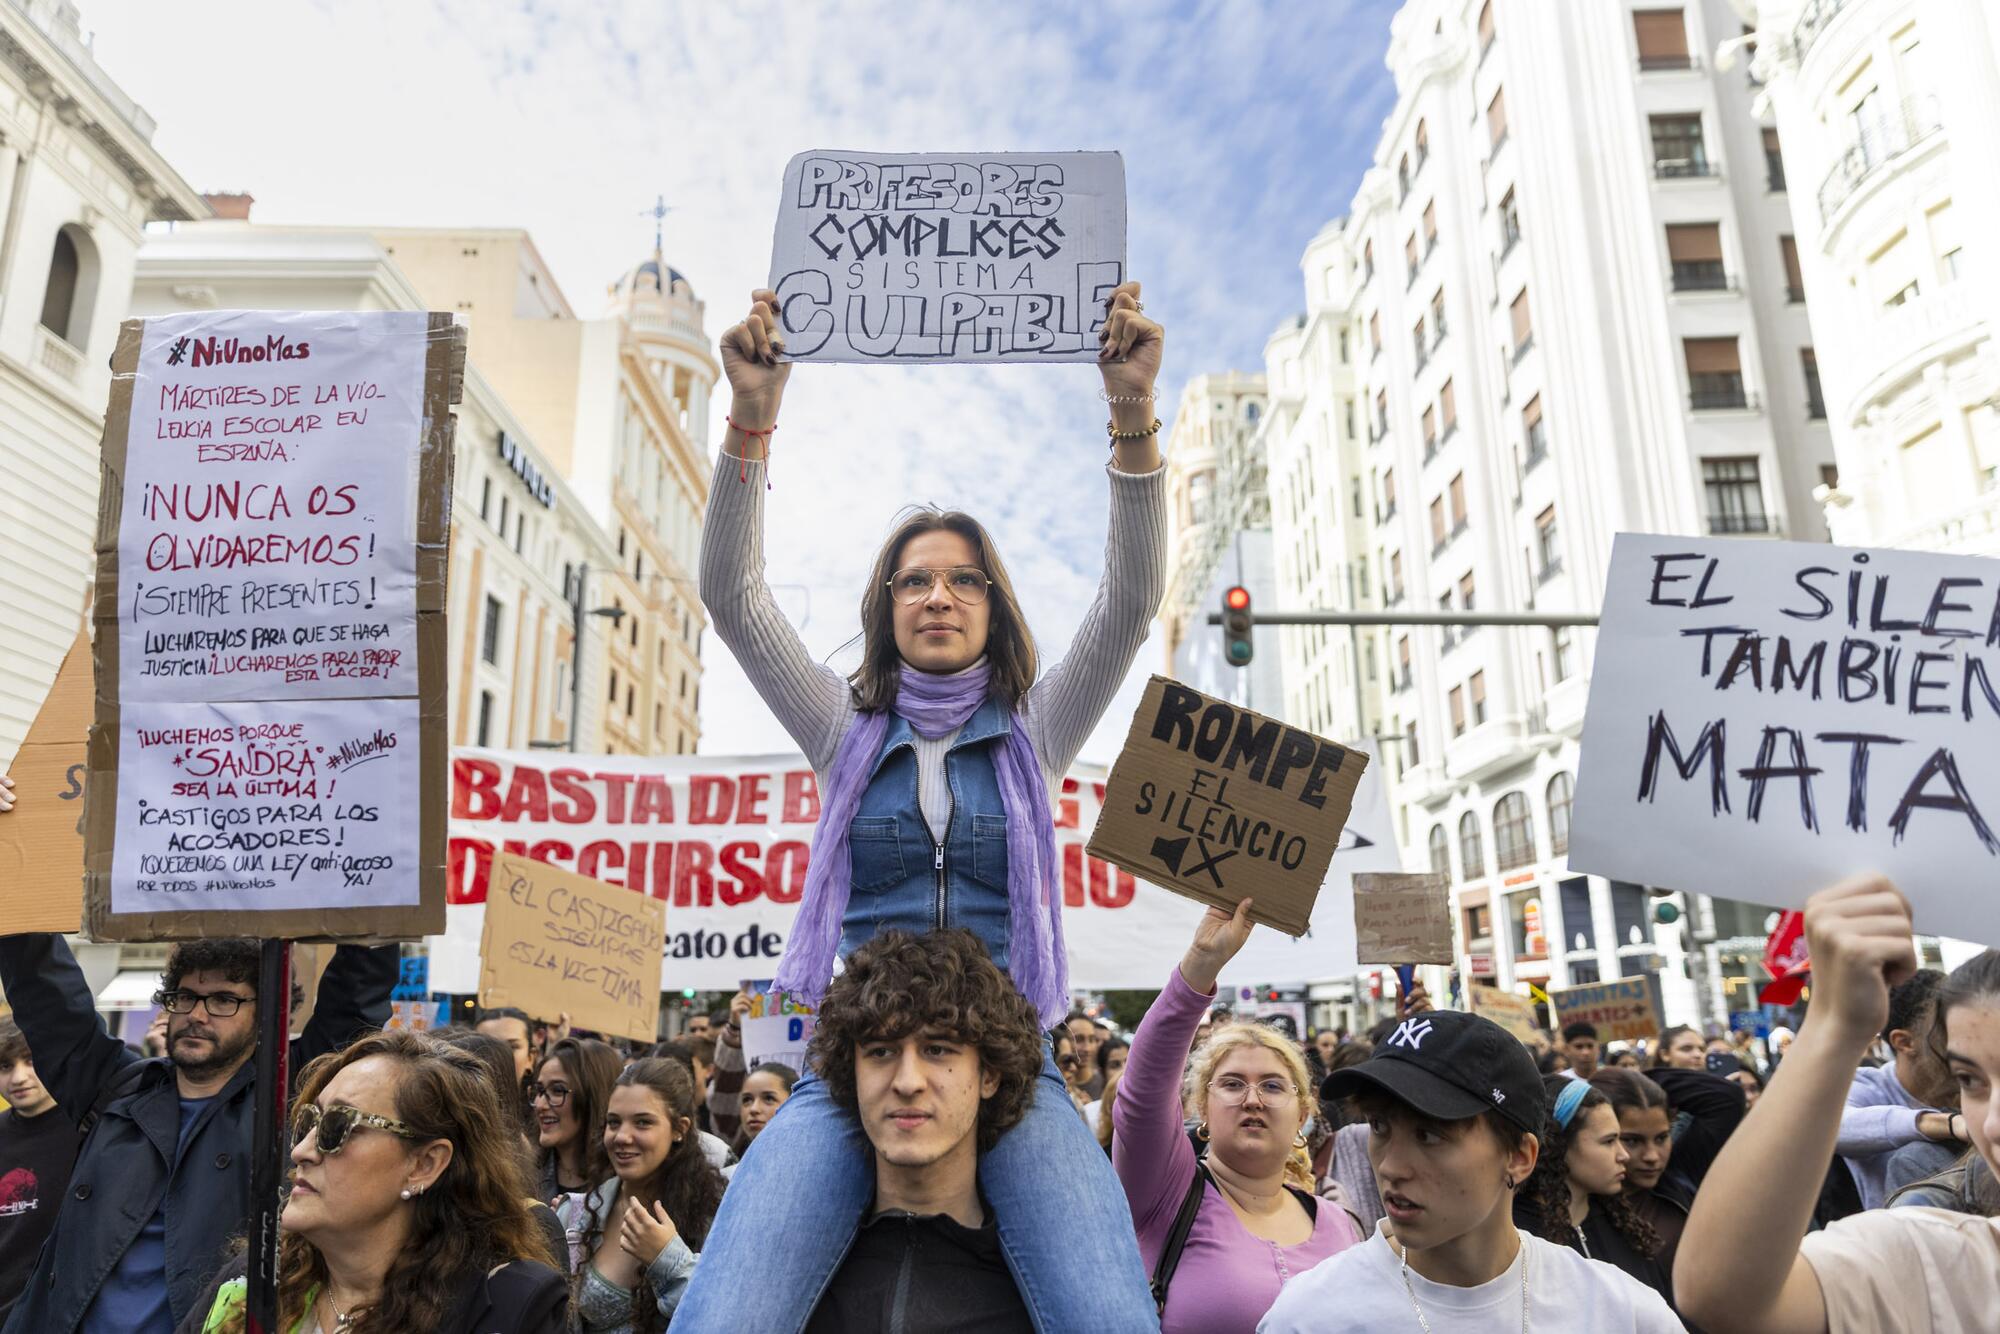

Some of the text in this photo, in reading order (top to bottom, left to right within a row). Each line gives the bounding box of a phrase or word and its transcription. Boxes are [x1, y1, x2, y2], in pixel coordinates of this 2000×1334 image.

[798, 158, 1063, 217] PROFESORES
[847, 262, 1033, 289] SISTEMA
[166, 335, 310, 367] #NiUnoMas
[270, 385, 301, 407] DE
[315, 384, 338, 404] LA
[224, 415, 322, 436] ESCOLAR
[337, 408, 367, 427] EN
[308, 485, 359, 516] OS
[1646, 553, 1734, 609] EL
[144, 623, 390, 654] LUCHAREMOS PARA QUE SE HAGA
[322, 651, 358, 669] PARA
[285, 670, 320, 684] ESTA
[239, 723, 304, 740] PORQUE
[1150, 684, 1345, 810] ROMPE
[171, 781, 210, 800] SEA
[216, 780, 238, 798] LA
[450, 758, 674, 824] BASTA
[688, 774, 771, 825] DE
[1185, 768, 1235, 811] EL
[1637, 709, 2000, 856] MATA
[257, 804, 322, 825] PARA
[335, 804, 379, 822] LOS
[1135, 781, 1307, 870] SILENCIO
[233, 854, 265, 872] UNA
[271, 853, 308, 881] LEY
[343, 873, 373, 888] YA!
[137, 879, 159, 892] POR
[162, 879, 198, 892] TODOS
[510, 877, 537, 909] EL
[733, 923, 782, 957] de
